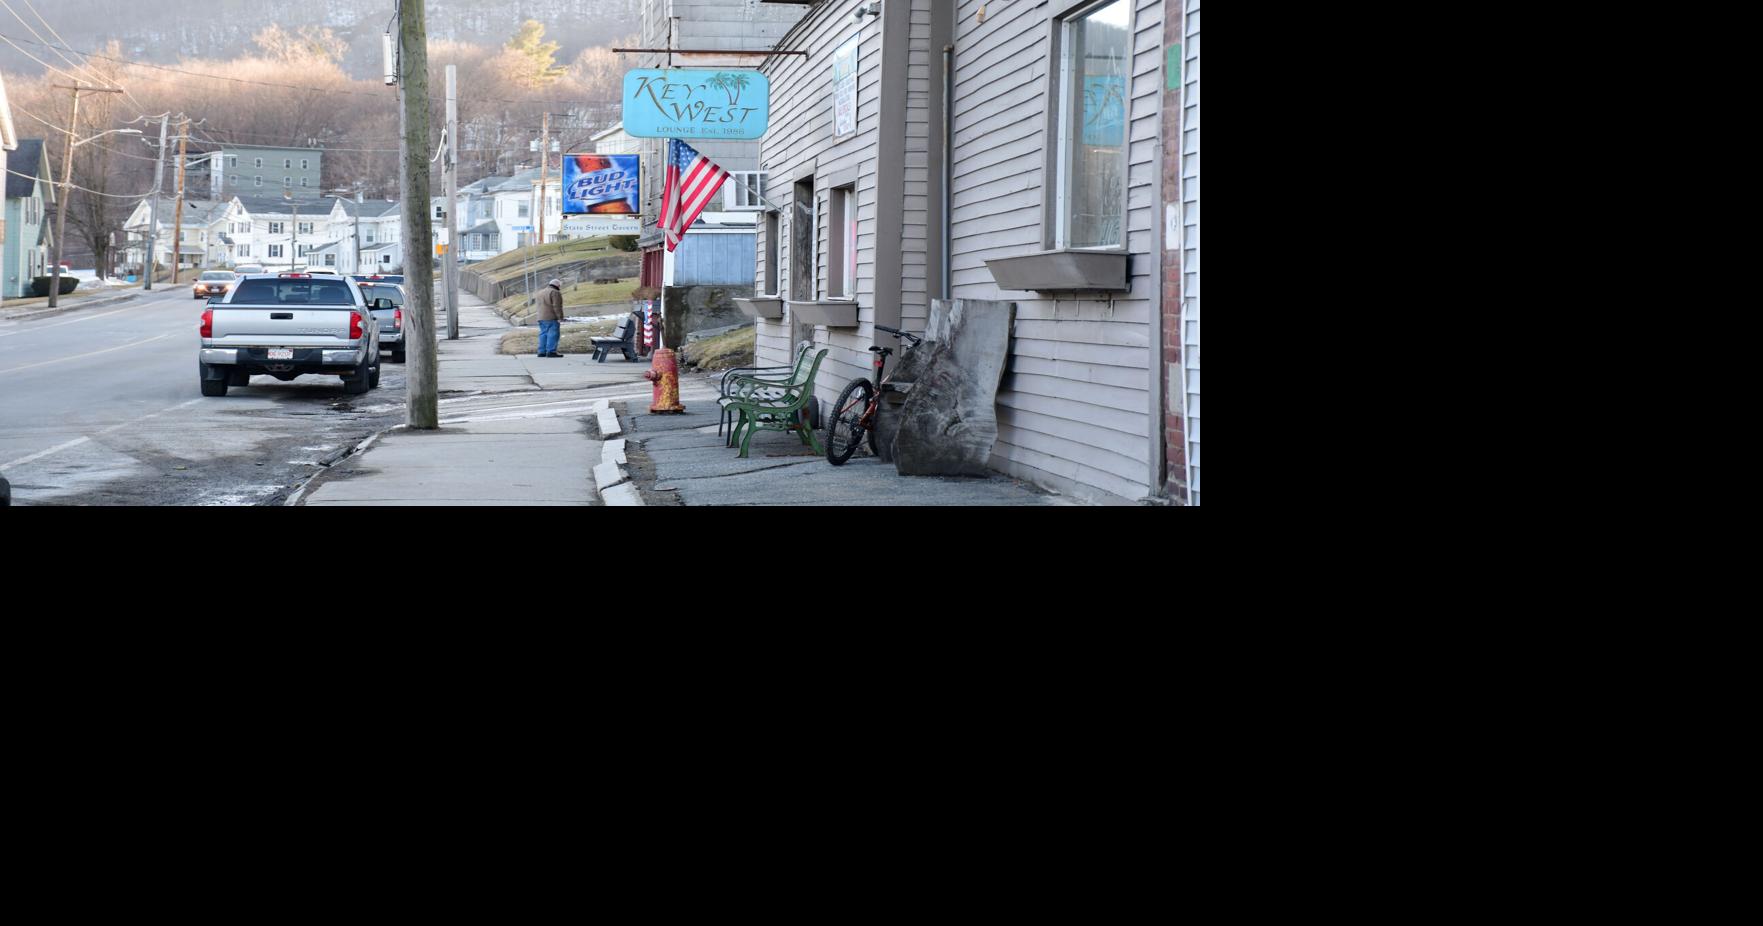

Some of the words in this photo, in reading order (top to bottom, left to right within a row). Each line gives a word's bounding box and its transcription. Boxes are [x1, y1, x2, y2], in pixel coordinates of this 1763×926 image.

[669, 101, 759, 123] WEST
[656, 126, 696, 134] LOUNGE
[577, 171, 625, 188] BUD
[569, 179, 636, 200] LIGHT
[563, 223, 584, 231] State
[612, 223, 639, 231] Tavern
